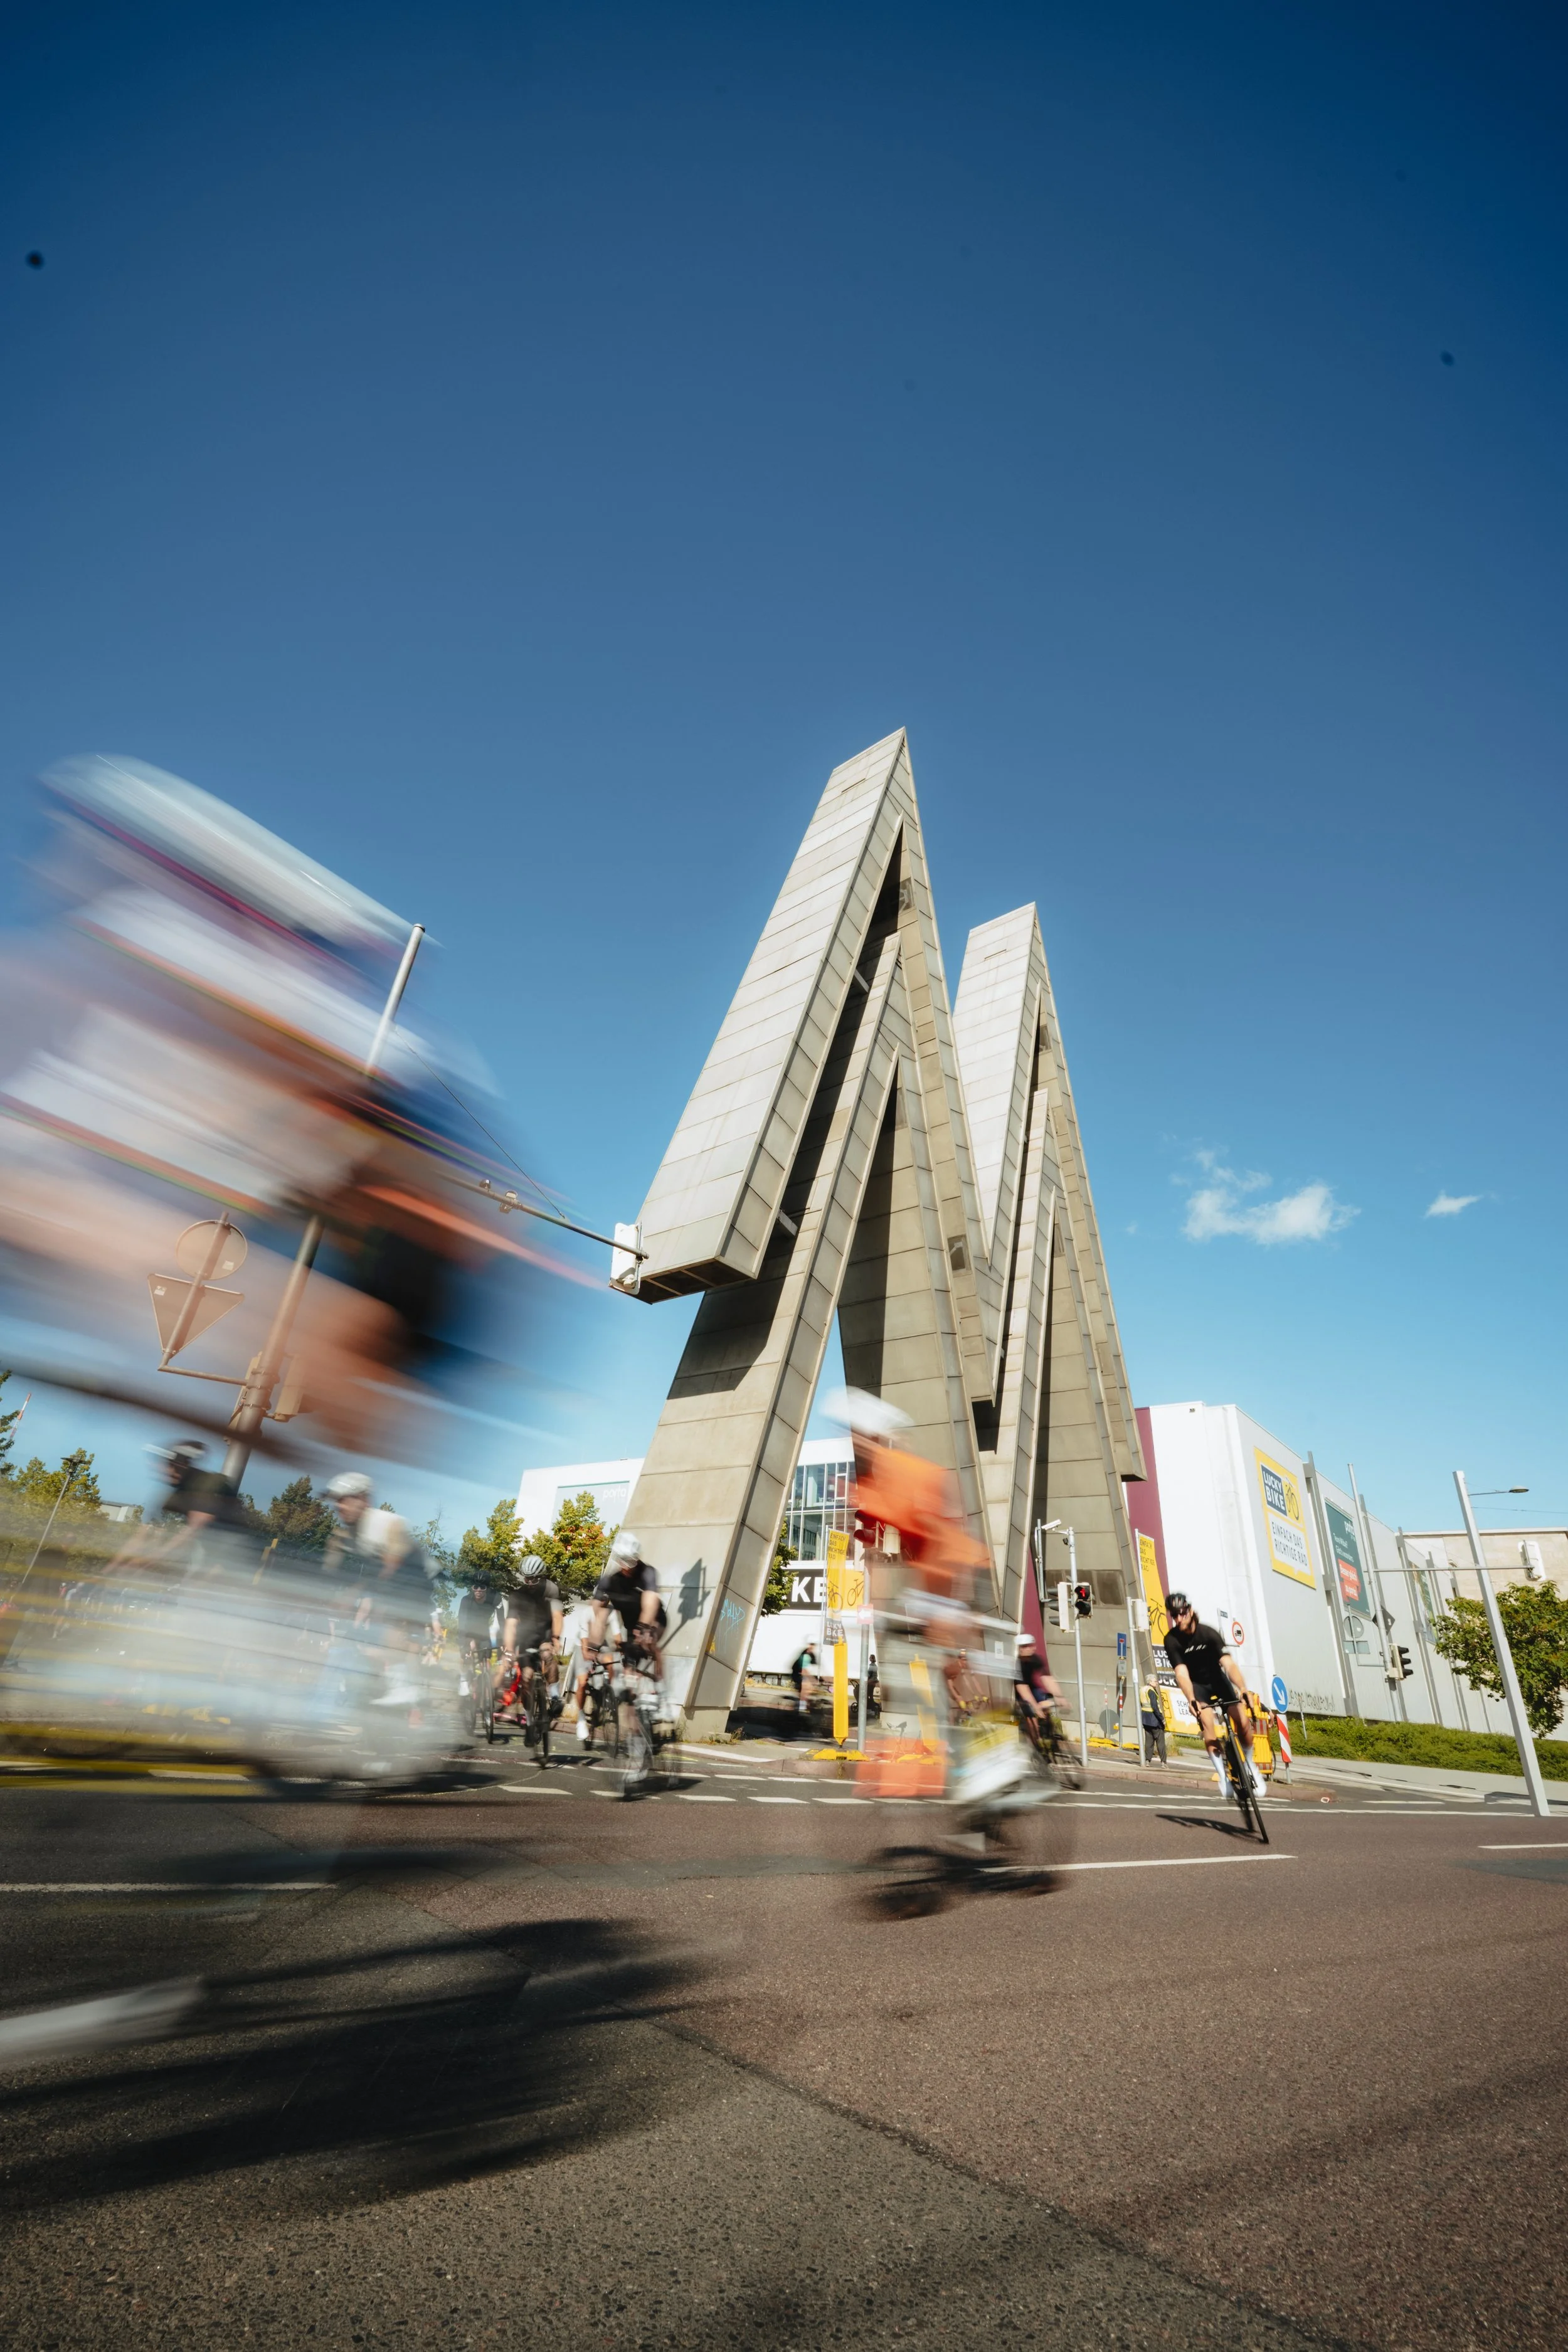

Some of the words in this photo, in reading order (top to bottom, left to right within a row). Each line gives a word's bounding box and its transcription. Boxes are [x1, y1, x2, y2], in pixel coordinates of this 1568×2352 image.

[1263, 1471, 1282, 1493] LUCKY
[1266, 1485, 1286, 1511] BIKE
[1272, 1522, 1293, 1544] EINFACH
[1293, 1534, 1303, 1550] DAS
[1274, 1538, 1298, 1562] RICHTIGE
[1298, 1551, 1308, 1566] RAD
[790, 1577, 827, 1602] KE
[1153, 1650, 1168, 1658] LUC
[1154, 1658, 1173, 1668] BIK
